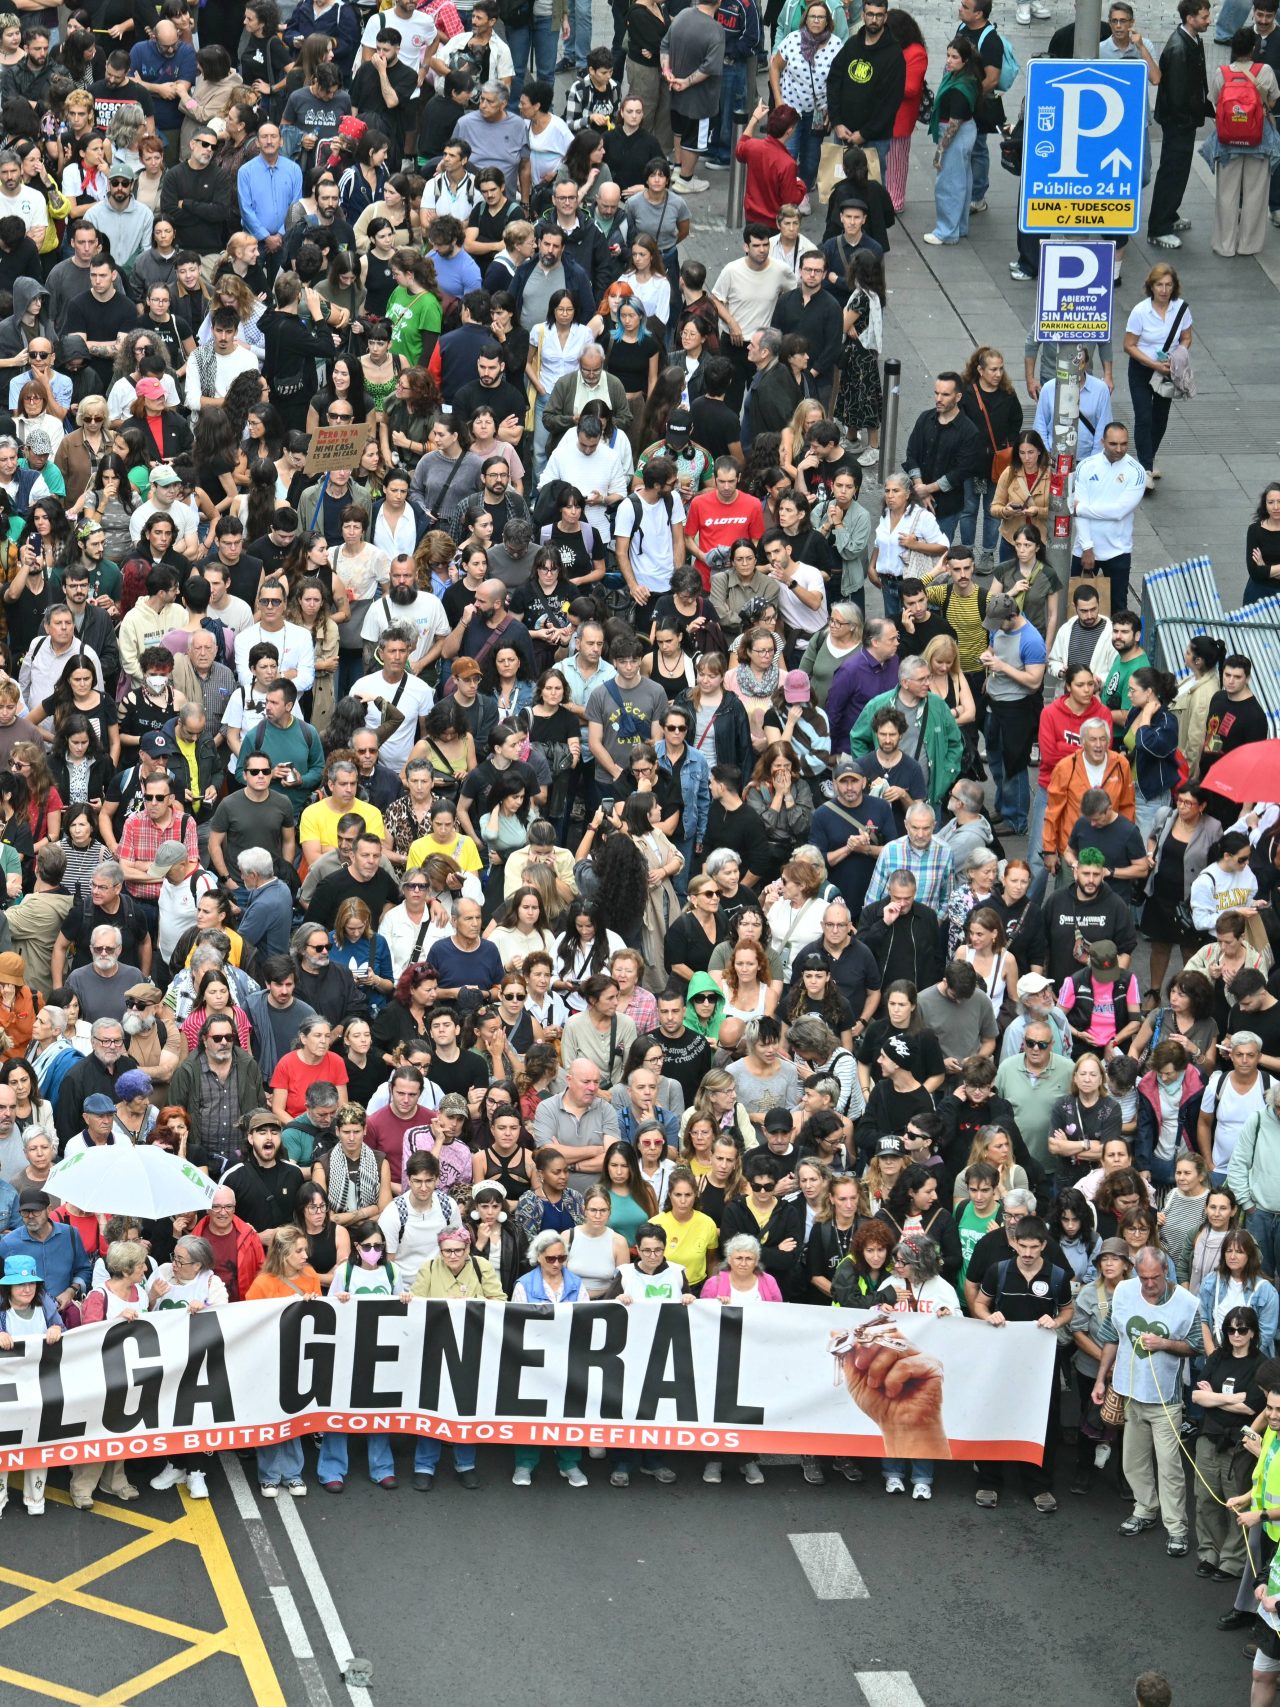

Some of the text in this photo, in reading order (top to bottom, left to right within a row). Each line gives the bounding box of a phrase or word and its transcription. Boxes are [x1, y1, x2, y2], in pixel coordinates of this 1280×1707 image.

[717, 13, 737, 28] Bull
[1048, 83, 1125, 178] P
[1033, 182, 1131, 196] Público 24 H
[1031, 202, 1062, 212] LUNA
[1070, 202, 1131, 212] TUDESCOS
[1057, 215, 1105, 225] C/ SILVA
[1043, 245, 1099, 311] P
[1061, 295, 1097, 303] ABIERTO
[1060, 302, 1074, 311] 24
[1041, 312, 1108, 321] SIN MULTAS
[1041, 322, 1107, 330] PARKING CALLAO
[1043, 331, 1105, 339] TUDESCOS 3
[334, 442, 354, 451] CASA
[341, 449, 358, 457] CASA
[713, 517, 748, 525] LOTTO
[617, 735, 641, 745] GYM
[880, 1138, 901, 1150] TRUE
[278, 1299, 765, 1426] GENERAL
[40, 1436, 169, 1464] FONDOS
[183, 1424, 292, 1449] BUITRE
[325, 1415, 515, 1440] CONTRATOS
[529, 1425, 741, 1447] INDEFINIDOS
